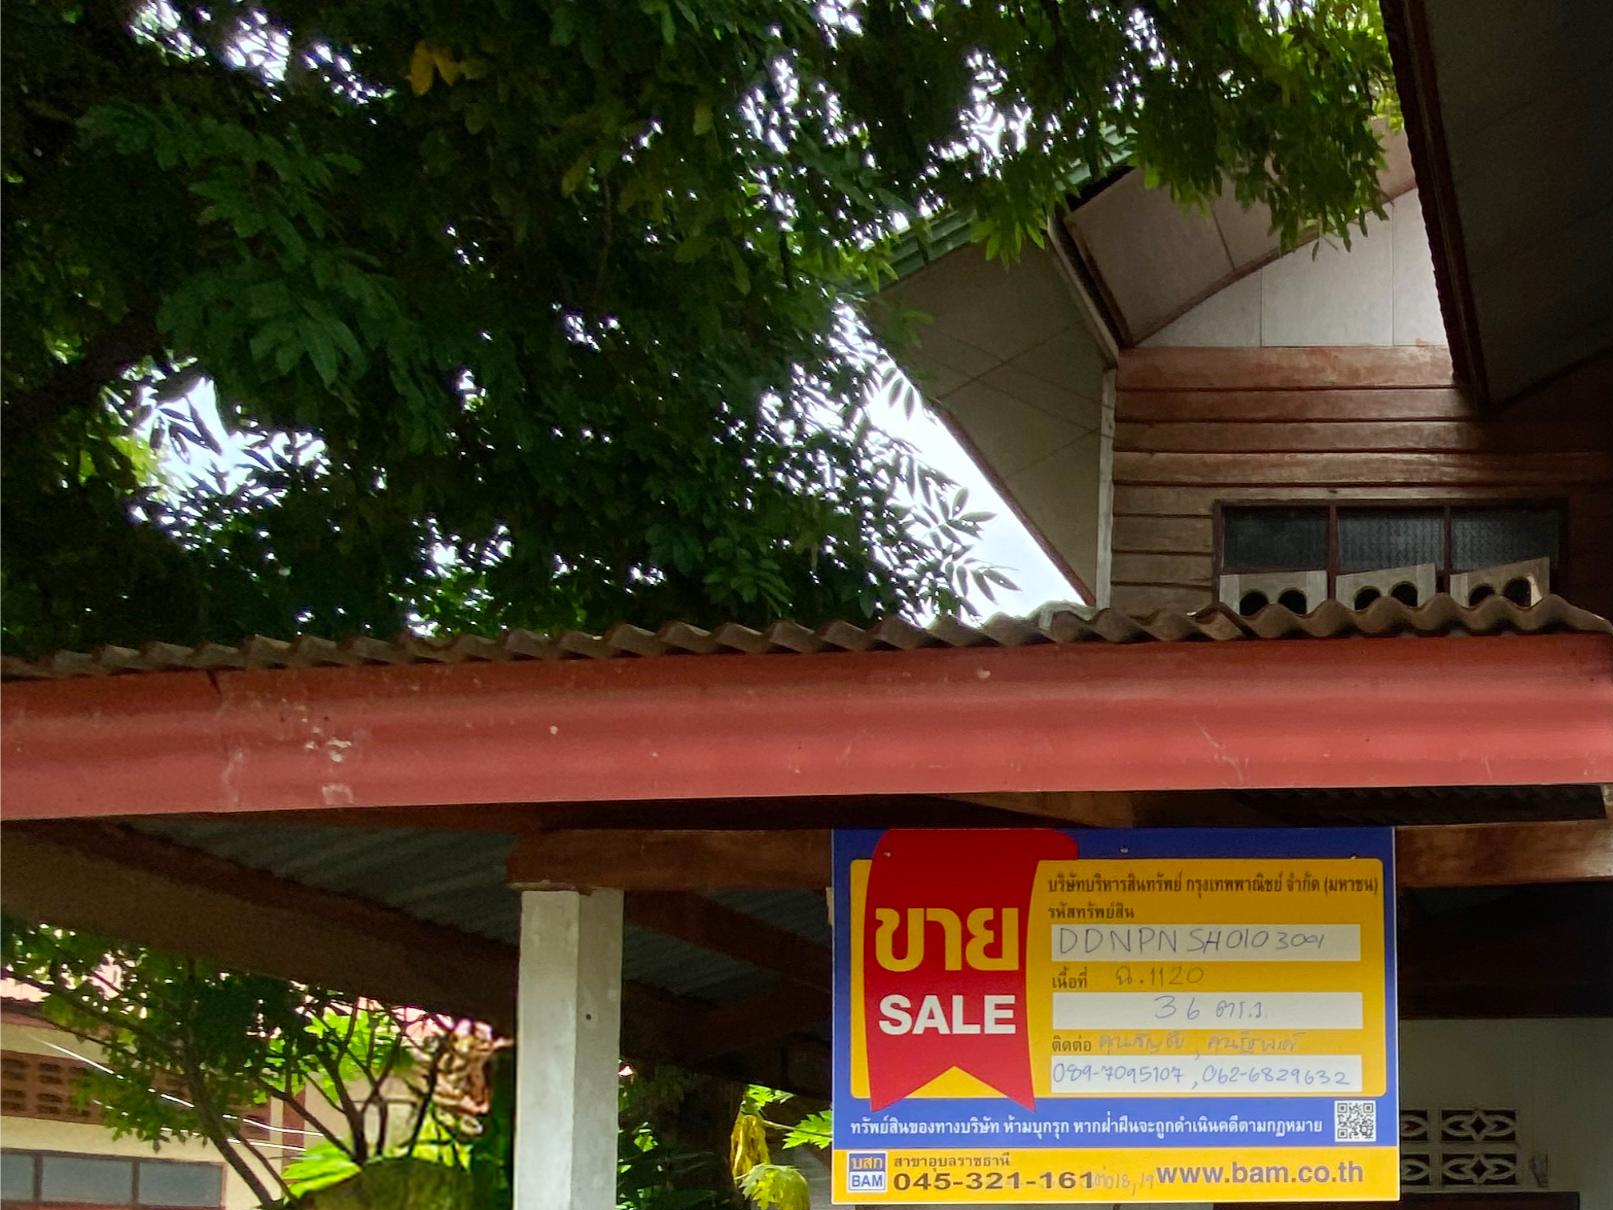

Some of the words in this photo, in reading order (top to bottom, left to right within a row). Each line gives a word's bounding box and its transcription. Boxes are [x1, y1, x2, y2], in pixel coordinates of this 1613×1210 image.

[1048, 870, 1182, 893] บริษัทบริหารสินทรัพย์
[1186, 875, 1283, 899] กรุงเทพพาณิชย์
[1287, 875, 1320, 893] จำกัด
[1324, 876, 1379, 895] (มหาชน)
[1048, 902, 1135, 920] รหัสทรัพย์สิน
[875, 907, 1019, 972] ขาย
[1052, 966, 1088, 989] เนื้อที่
[879, 994, 1016, 1035] SALE
[1052, 1036, 1092, 1052] ติดต่อ
[850, 1115, 1000, 1135] ทรัพย์สินของทางบริษัท
[1003, 1115, 1070, 1139] ห้ามบุกรุก
[894, 1152, 1011, 1172] สาขาอุบลราชธานี
[1156, 1160, 1364, 1184] www.bam.co.th
[851, 1174, 883, 1187] BAM
[893, 1171, 1094, 1191] 045-321-161
